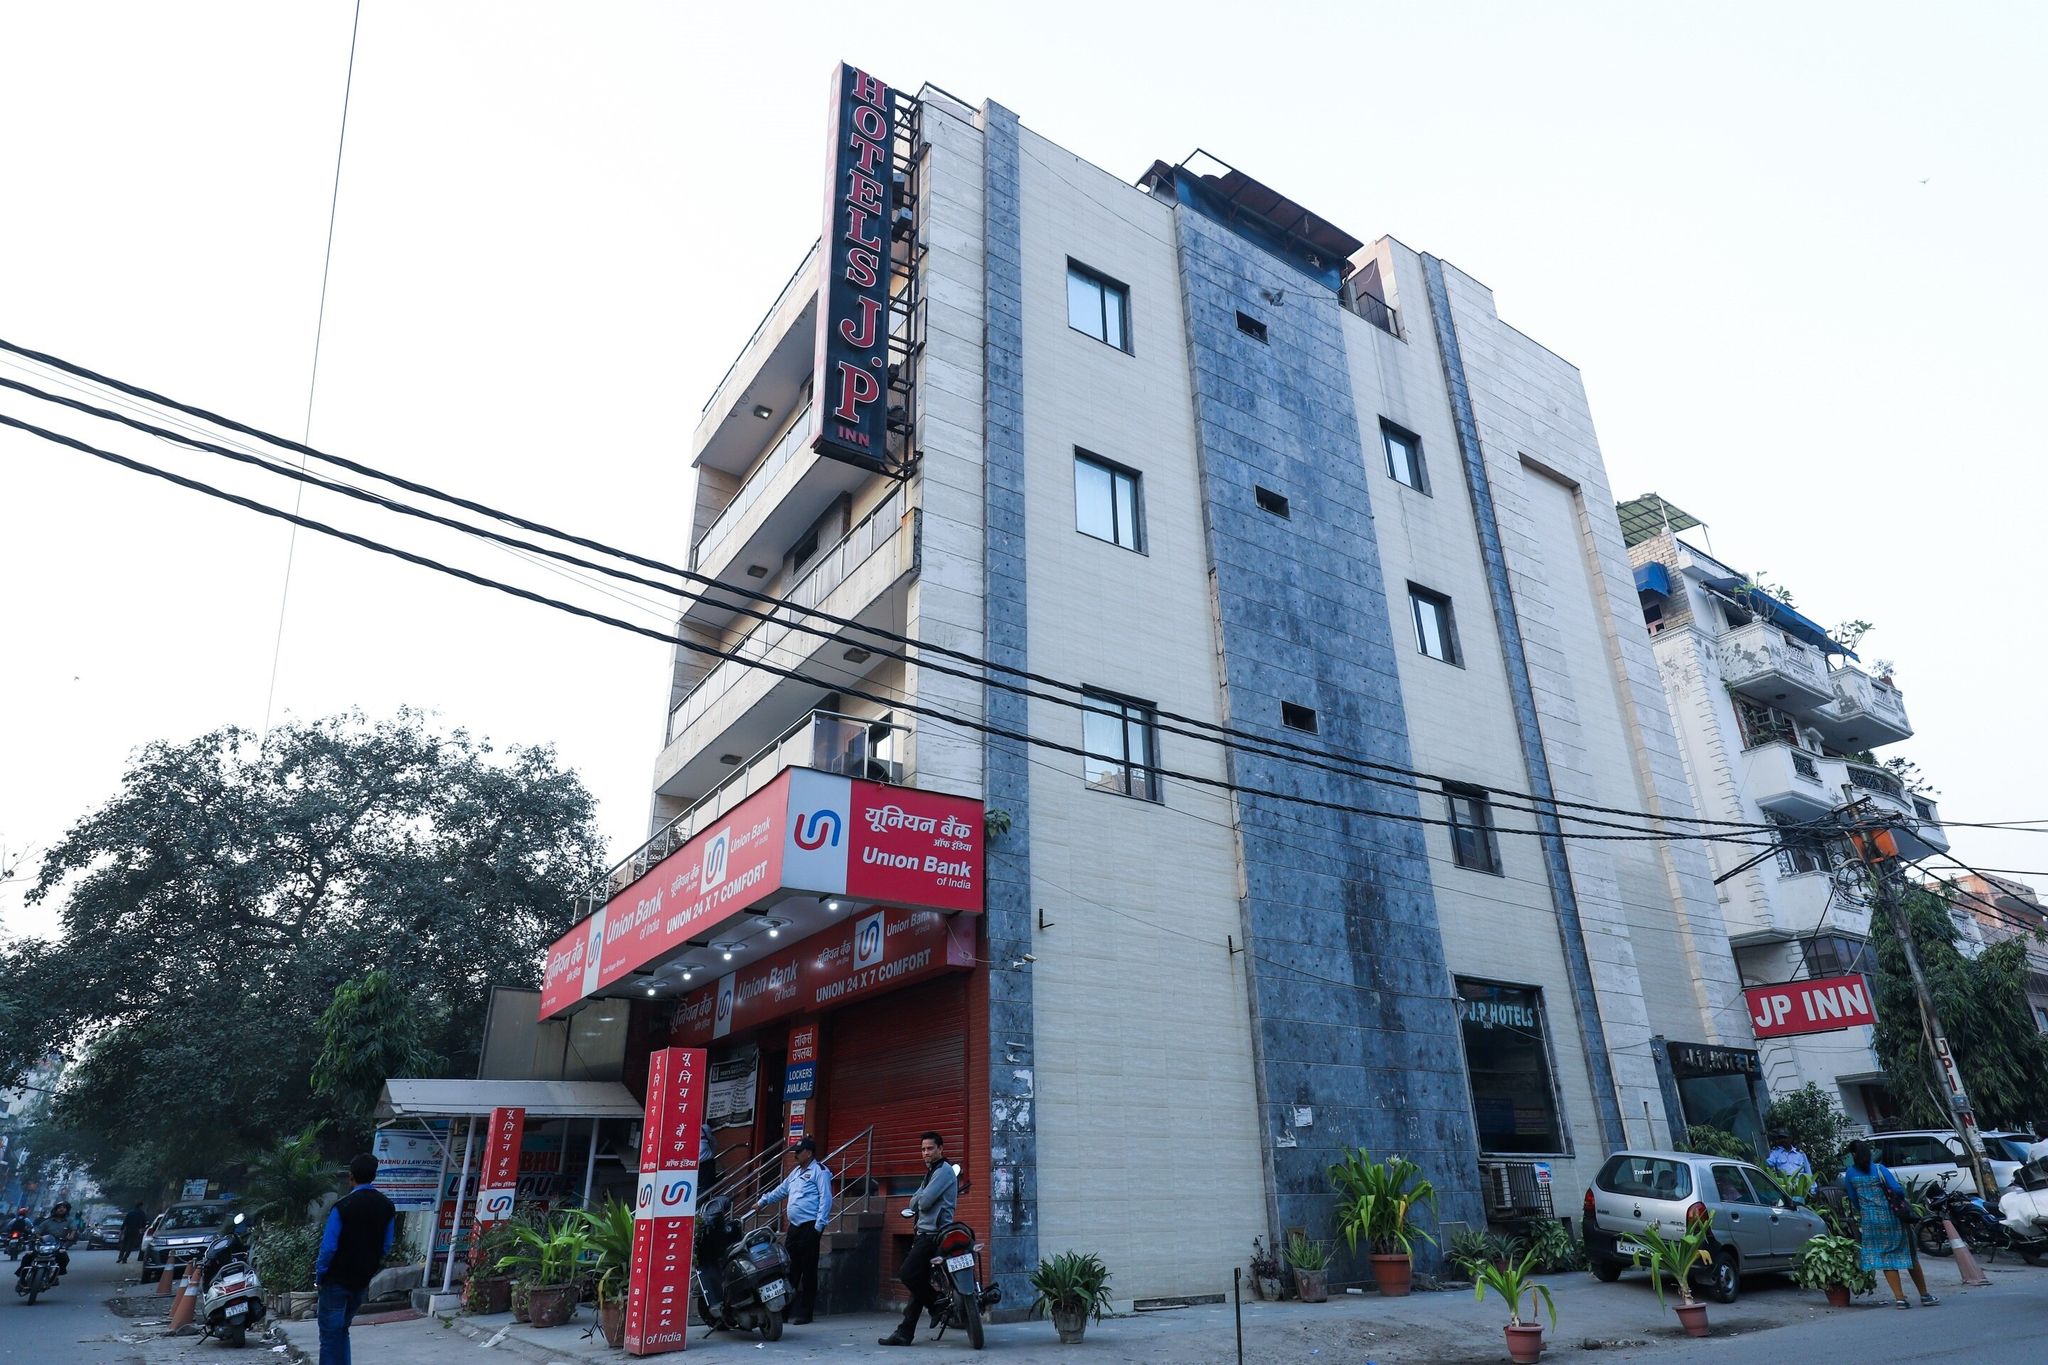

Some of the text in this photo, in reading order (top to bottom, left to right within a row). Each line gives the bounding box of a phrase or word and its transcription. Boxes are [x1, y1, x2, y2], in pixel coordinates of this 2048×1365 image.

[846, 66, 888, 288] HOTELS
[838, 424, 870, 448] INN
[730, 816, 771, 853] Union Bank
[864, 805, 972, 838] यूनियन बैंक
[863, 846, 972, 878] Union Bank
[667, 861, 767, 934] UNION 24 X 7 COMFORT
[936, 877, 971, 889] of India
[606, 887, 663, 945] Union Bank
[886, 918, 910, 937] Union
[737, 959, 800, 1003] Union Bank
[816, 948, 932, 1003] UNION 24 X 7 COMFORT
[1490, 1003, 1533, 1027] HOTELS
[1755, 984, 1868, 1028] JP INN
[786, 1081, 813, 1094] AVAILABLE
[788, 1068, 813, 1081] LOCKERS
[631, 1224, 646, 1328] Union Bank
[660, 1221, 680, 1326] Union Bank
[646, 1332, 681, 1345] of India
